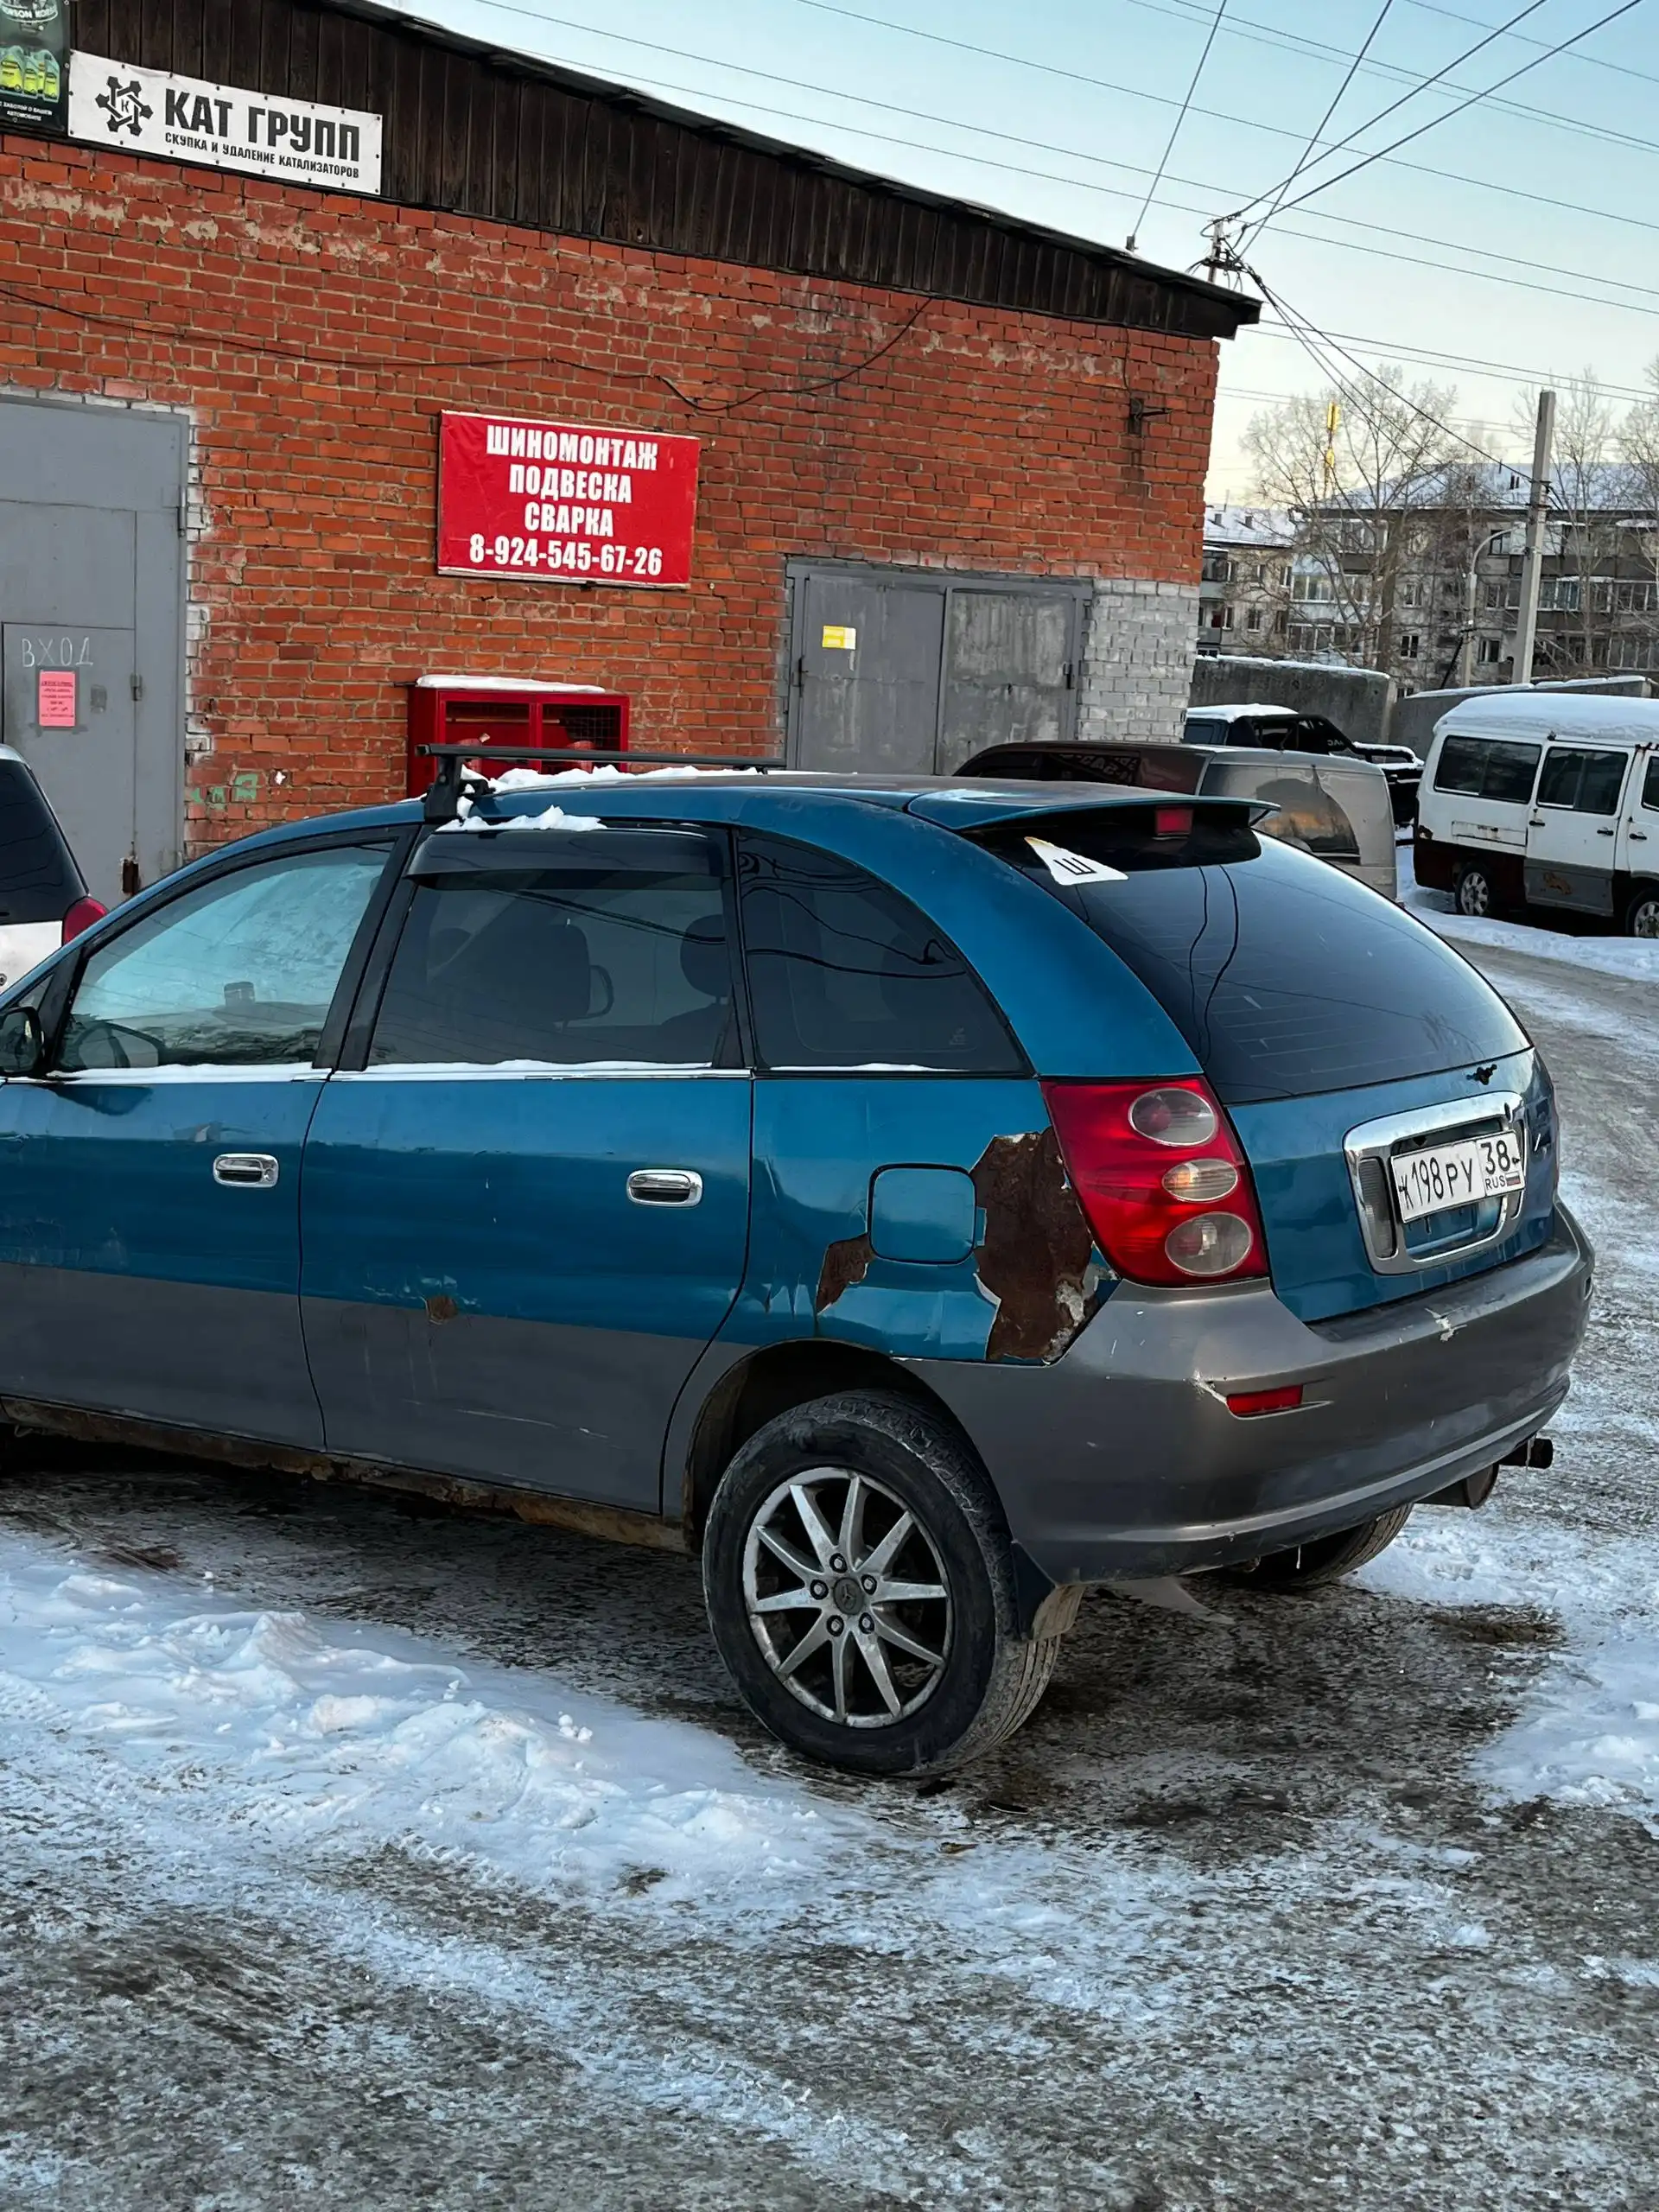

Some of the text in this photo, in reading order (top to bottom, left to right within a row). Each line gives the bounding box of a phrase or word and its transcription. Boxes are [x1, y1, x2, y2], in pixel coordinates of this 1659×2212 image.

[165, 88, 359, 162] КАТ ГРУПП
[165, 132, 359, 178] СКУПКА И УДАЛЕНИЕ КАТАЛИЗАТОРОВ
[486, 424, 658, 471] ШИНОМОНТАЖ
[509, 464, 632, 503] ПОДВЕСКА
[524, 501, 613, 537] СВАРКА
[469, 533, 662, 575] 8-924-545-67-26
[22, 637, 93, 667] ВХОД
[1480, 1140, 1510, 1175] 38
[1484, 1175, 1505, 1190] RUS
